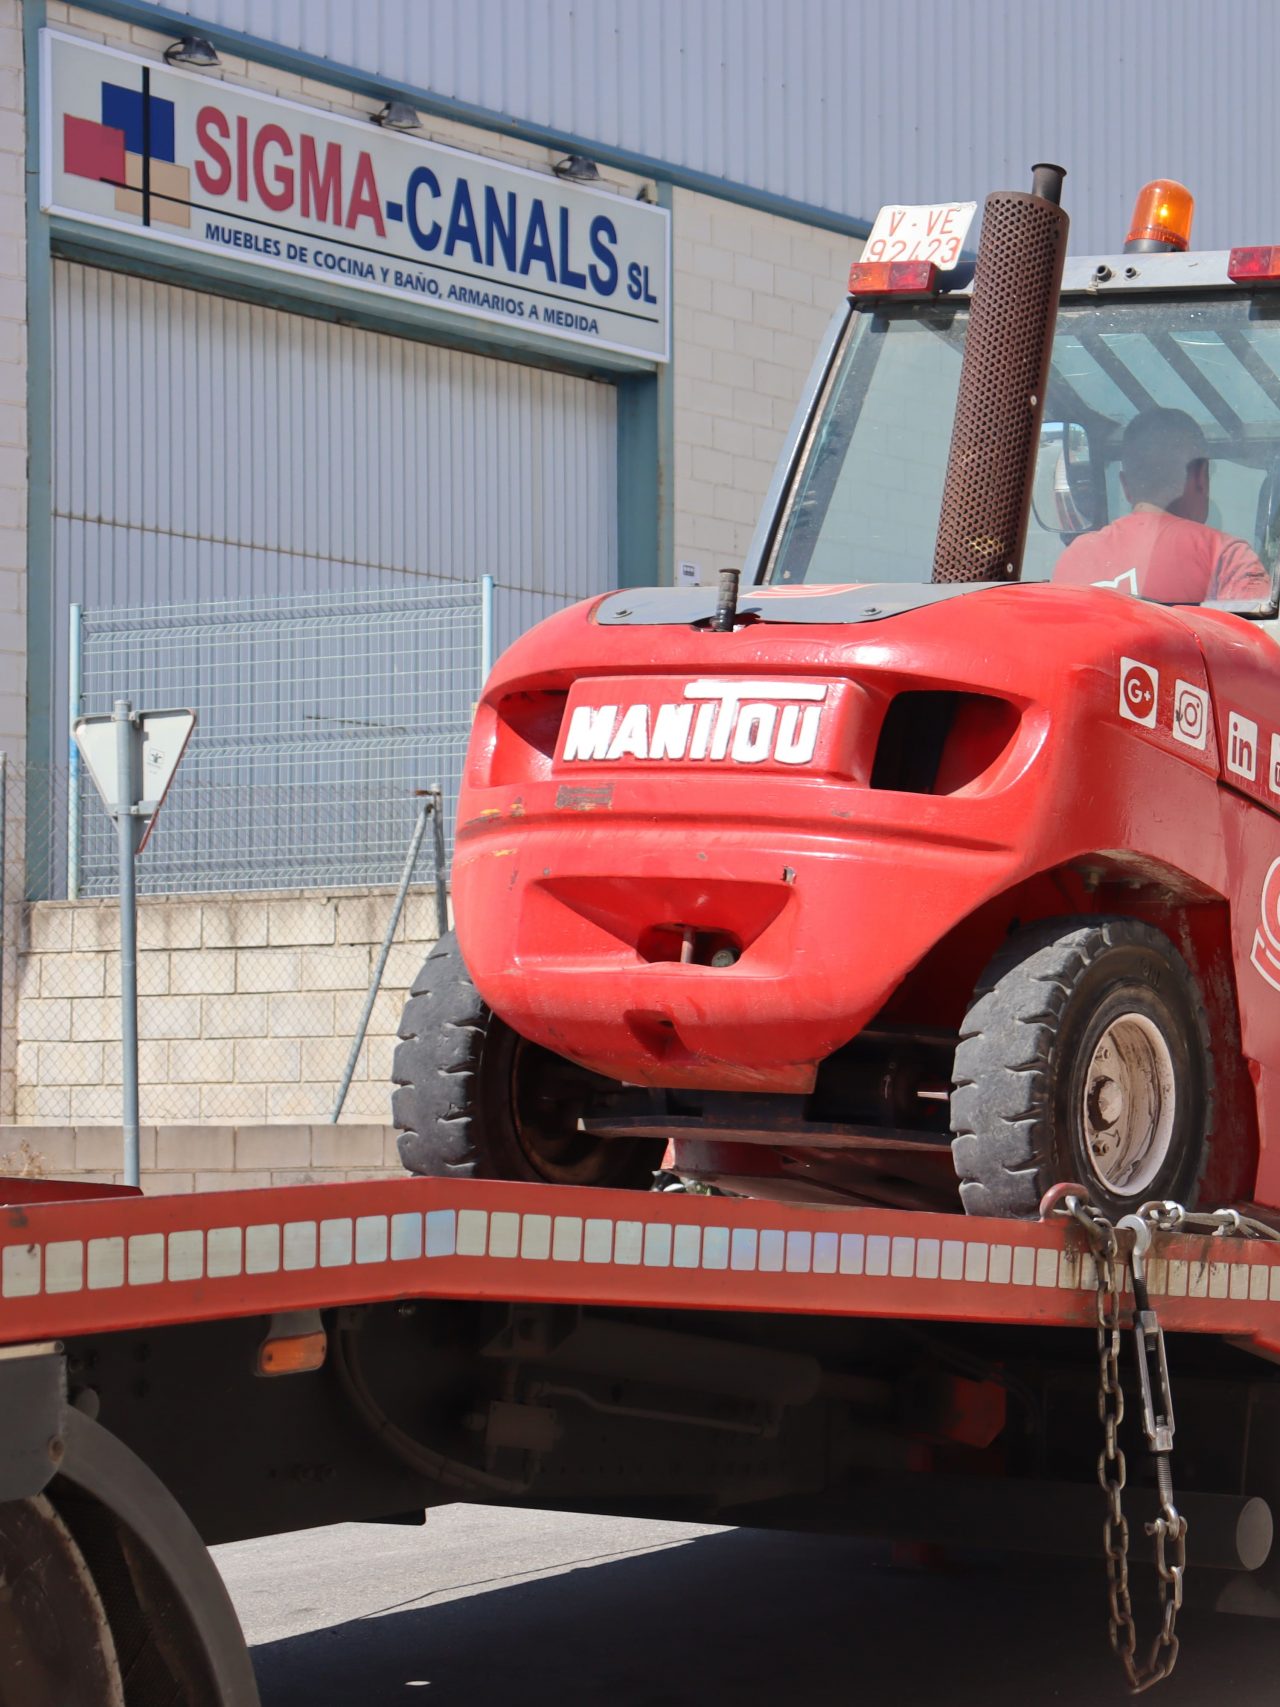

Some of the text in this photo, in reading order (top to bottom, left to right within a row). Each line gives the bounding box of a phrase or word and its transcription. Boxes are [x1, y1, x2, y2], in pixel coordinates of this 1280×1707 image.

[194, 105, 657, 305] SIGMA-CANALS SL
[205, 223, 599, 334] MUEBLES DE COCINA Y BAÑO, ARMARIOS A MEDIDA
[562, 678, 829, 765] MANITOU
[1231, 721, 1252, 772] in
